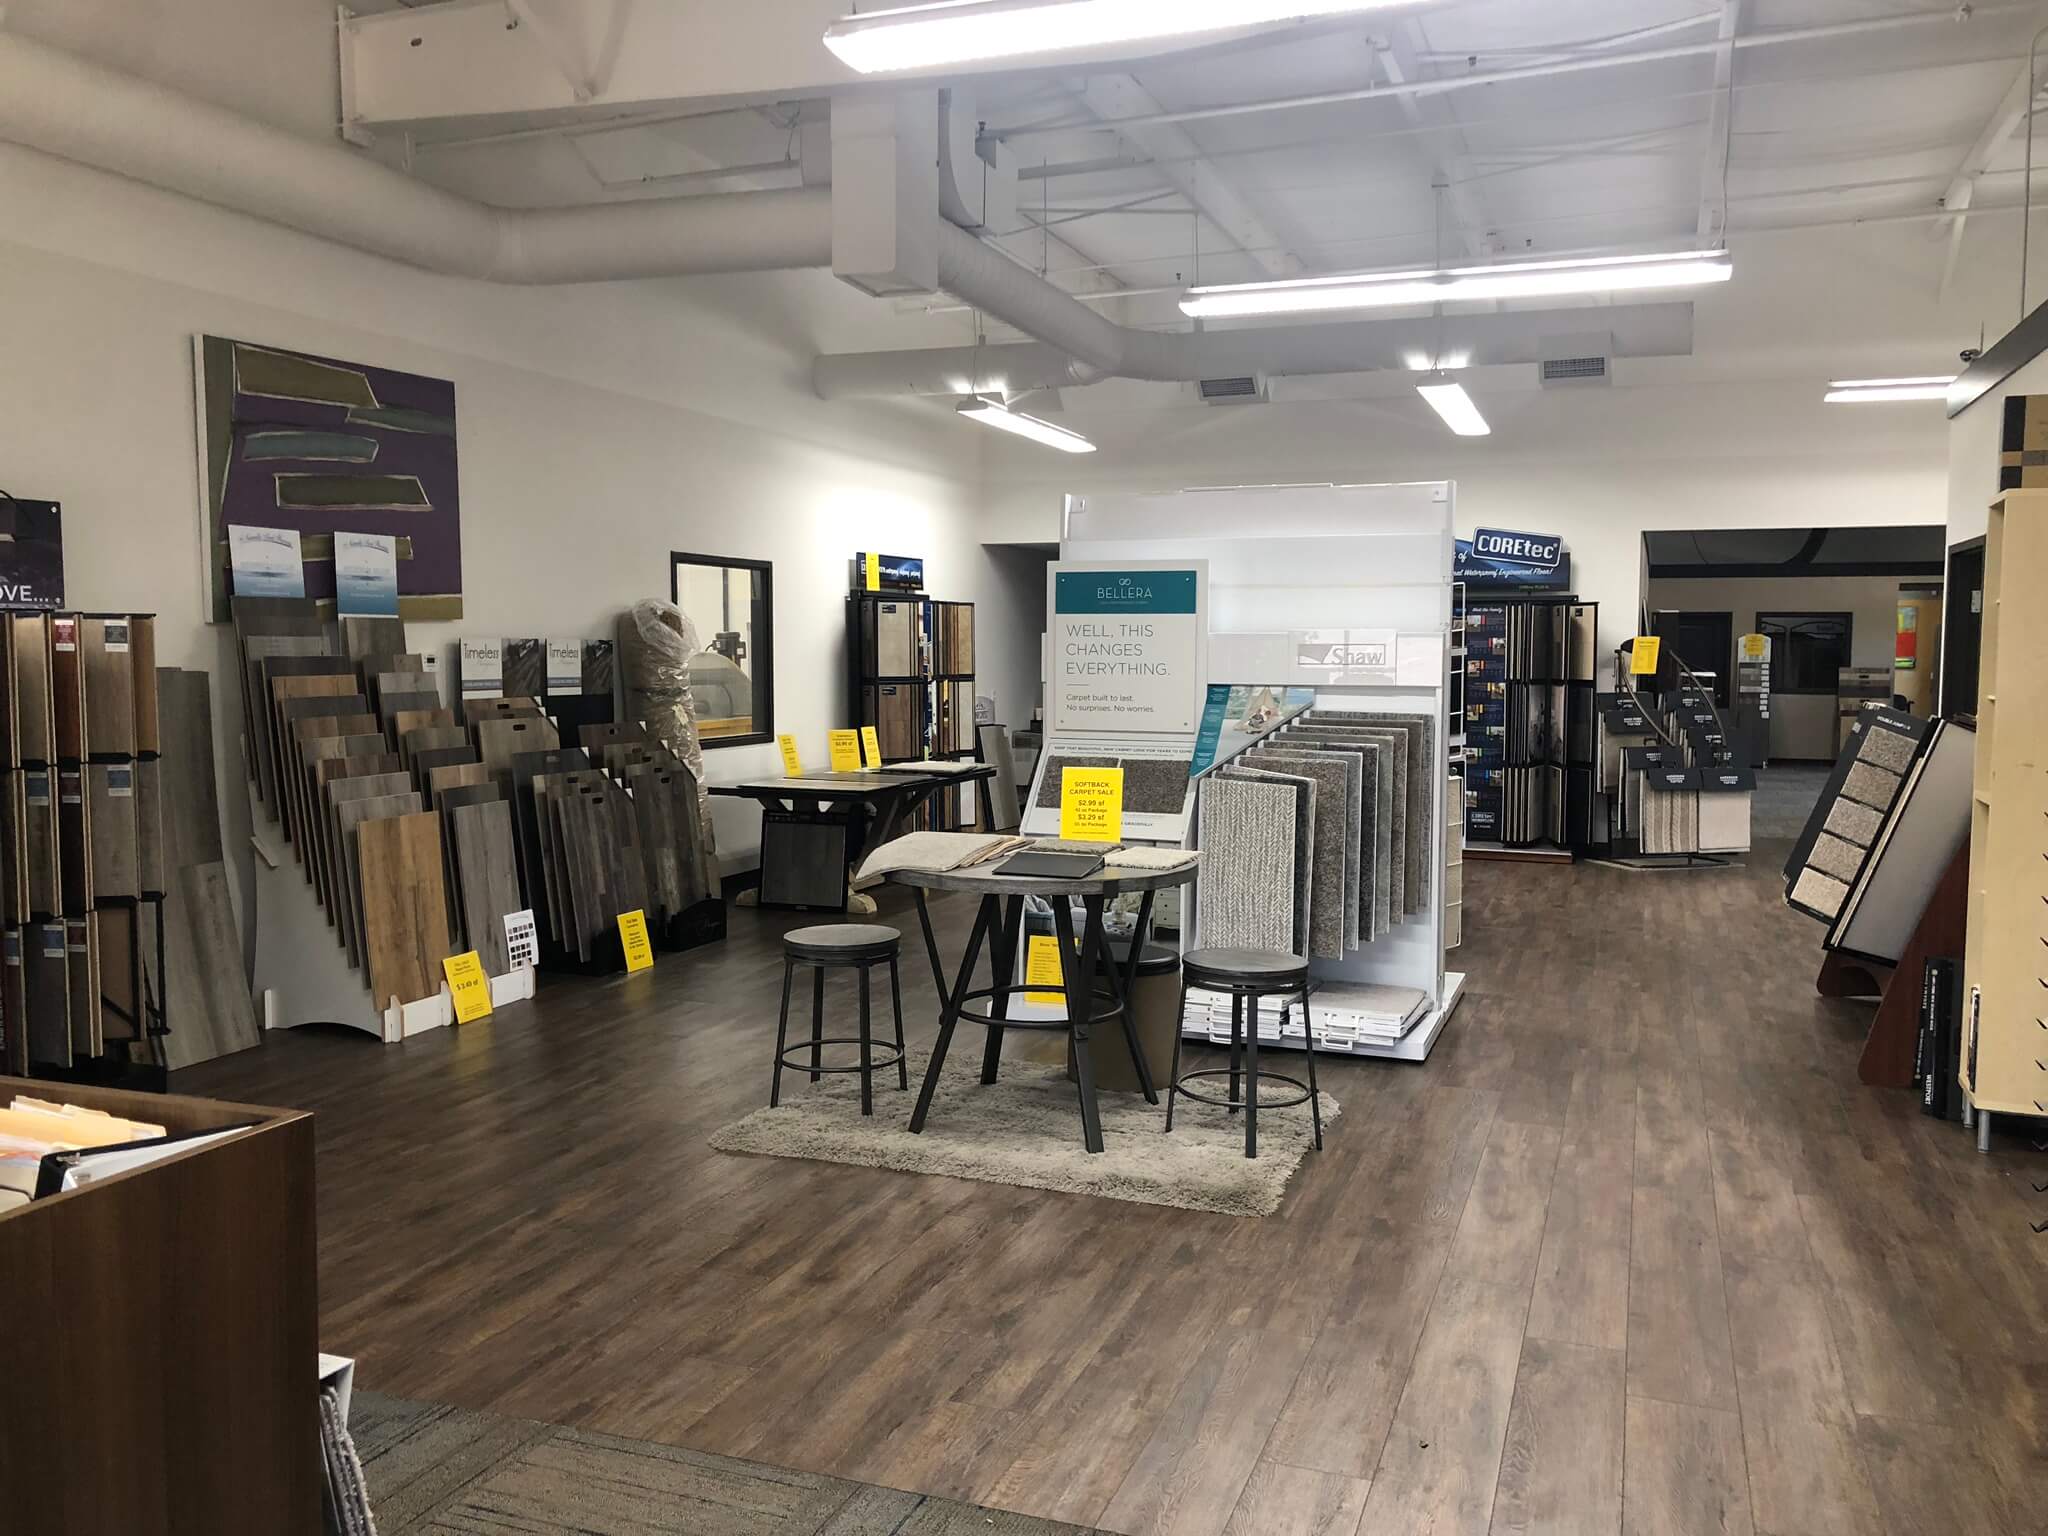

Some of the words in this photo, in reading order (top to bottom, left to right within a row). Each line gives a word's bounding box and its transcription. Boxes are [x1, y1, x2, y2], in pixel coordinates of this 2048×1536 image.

[1097, 587, 1153, 599] BELLERA
[1066, 624, 1114, 638] WELL,
[1120, 624, 1154, 637] THIS
[1066, 643, 1143, 657] CHANGES
[1332, 647, 1383, 665] Shaw
[1066, 662, 1171, 676] EVERYTHING.
[1066, 694, 1091, 702] Carpet
[1092, 694, 1108, 702] built
[1078, 705, 1112, 713] surprises.
